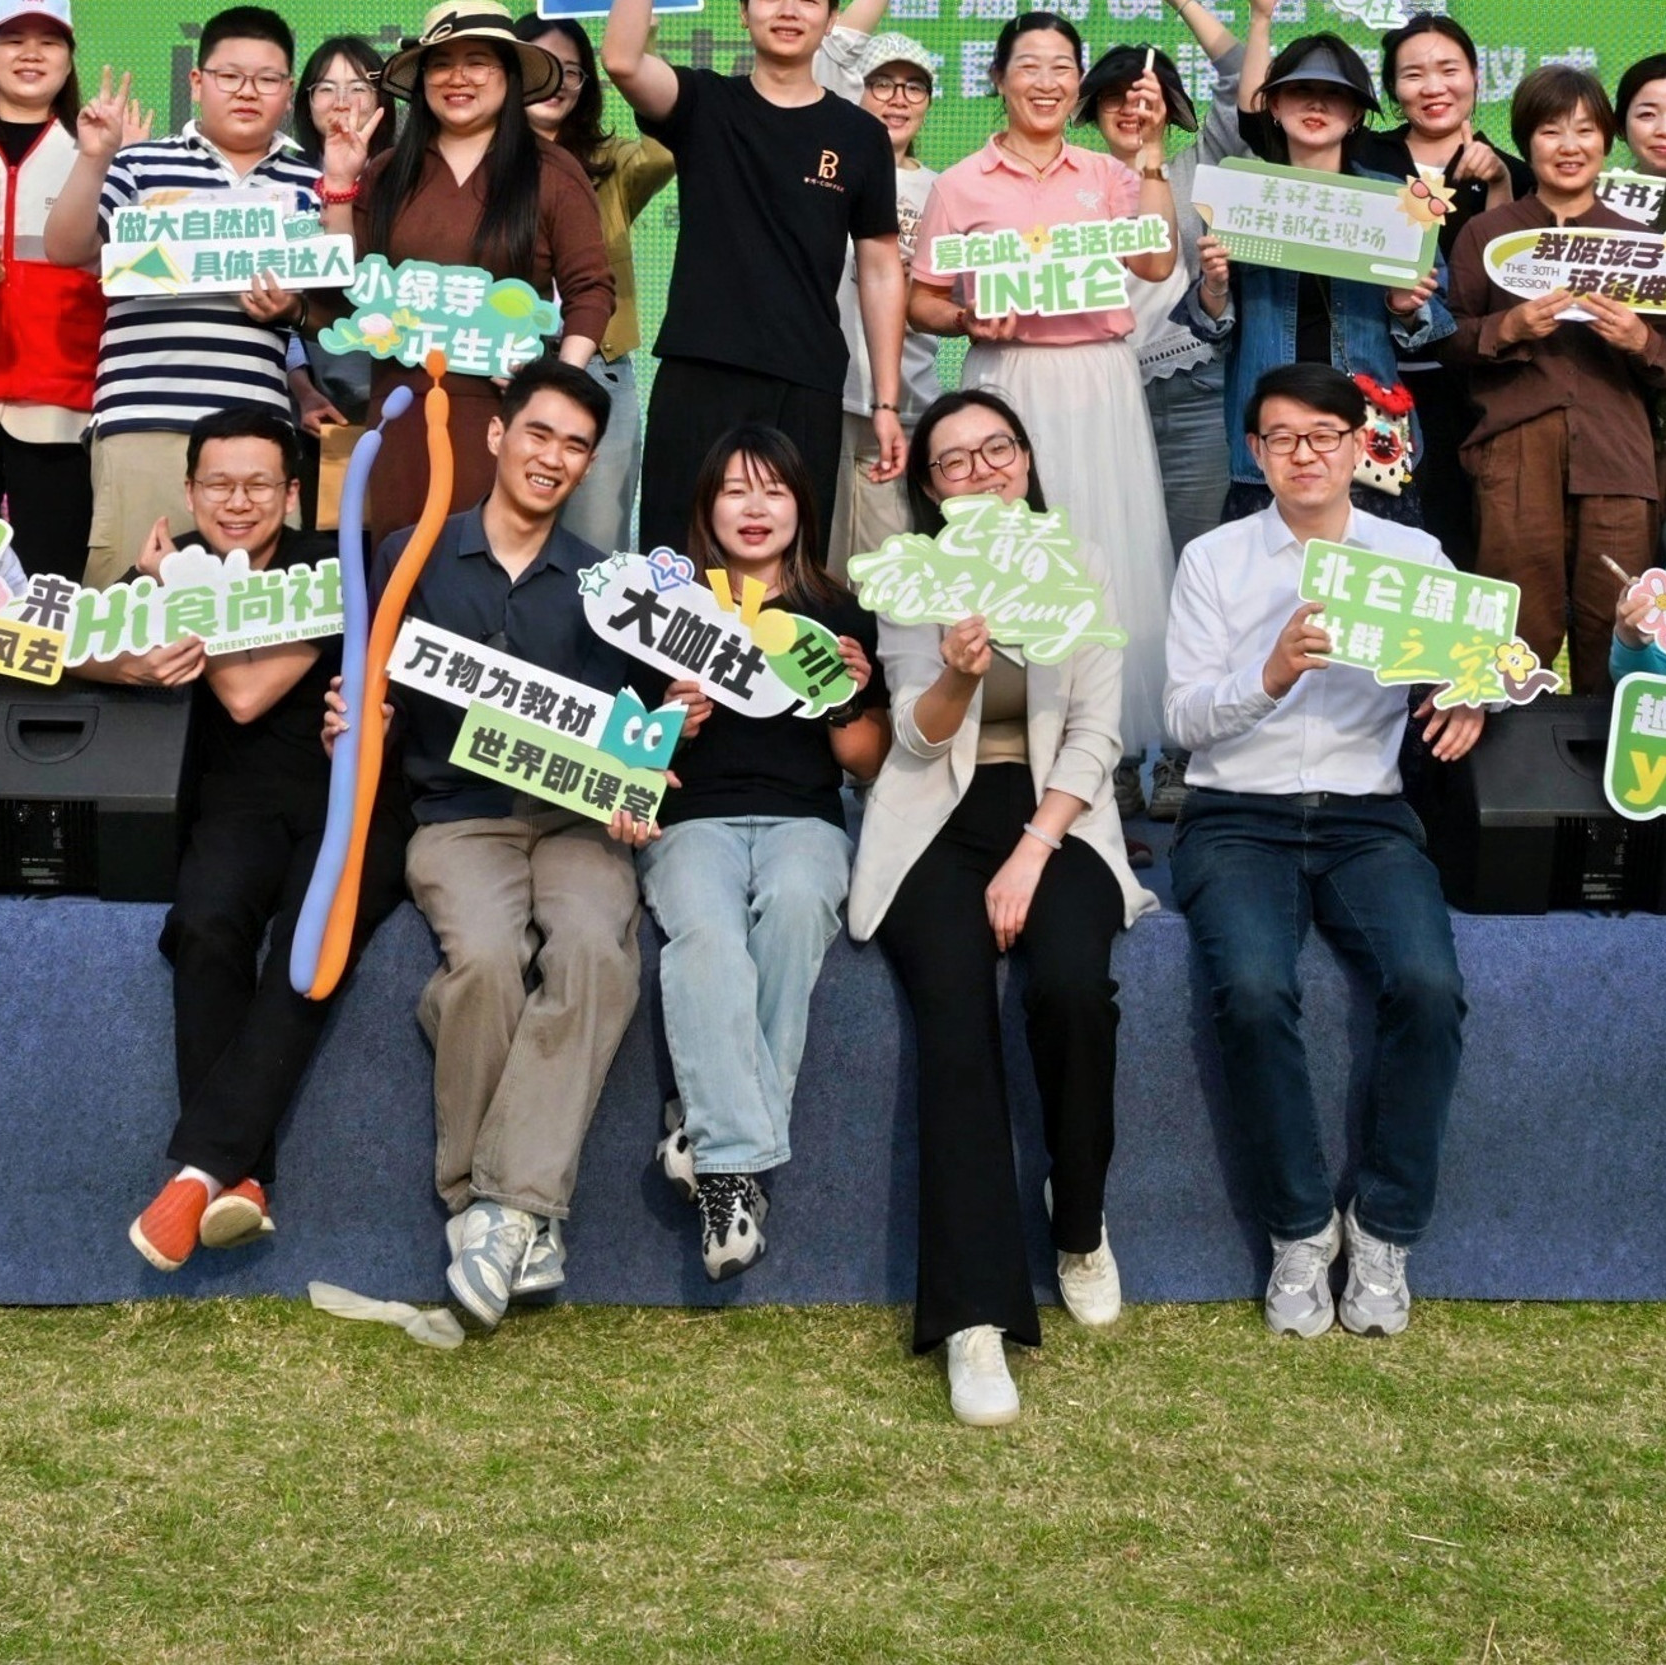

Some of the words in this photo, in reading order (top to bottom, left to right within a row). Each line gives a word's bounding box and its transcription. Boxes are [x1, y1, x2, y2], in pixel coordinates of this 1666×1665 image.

[1259, 178, 1366, 218] 美好生活
[115, 208, 276, 243] 做大自然的
[1228, 205, 1387, 252] 你我都在现场
[191, 246, 351, 282] 具体表达人
[1505, 262, 1527, 276] THE
[1532, 265, 1560, 277] 30TH
[1531, 232, 1665, 269] 我陪孩子
[350, 262, 487, 318] 小绿芽
[979, 257, 1127, 315] IN北仑
[1502, 276, 1552, 291] SESSION
[1310, 550, 1511, 638] 北仑绿城
[207, 632, 283, 654] GREENTOWN
[286, 630, 298, 641] IN
[606, 586, 766, 702] 大咖社
[403, 635, 597, 739] 万物为教材
[466, 725, 660, 825] 世界即课堂
